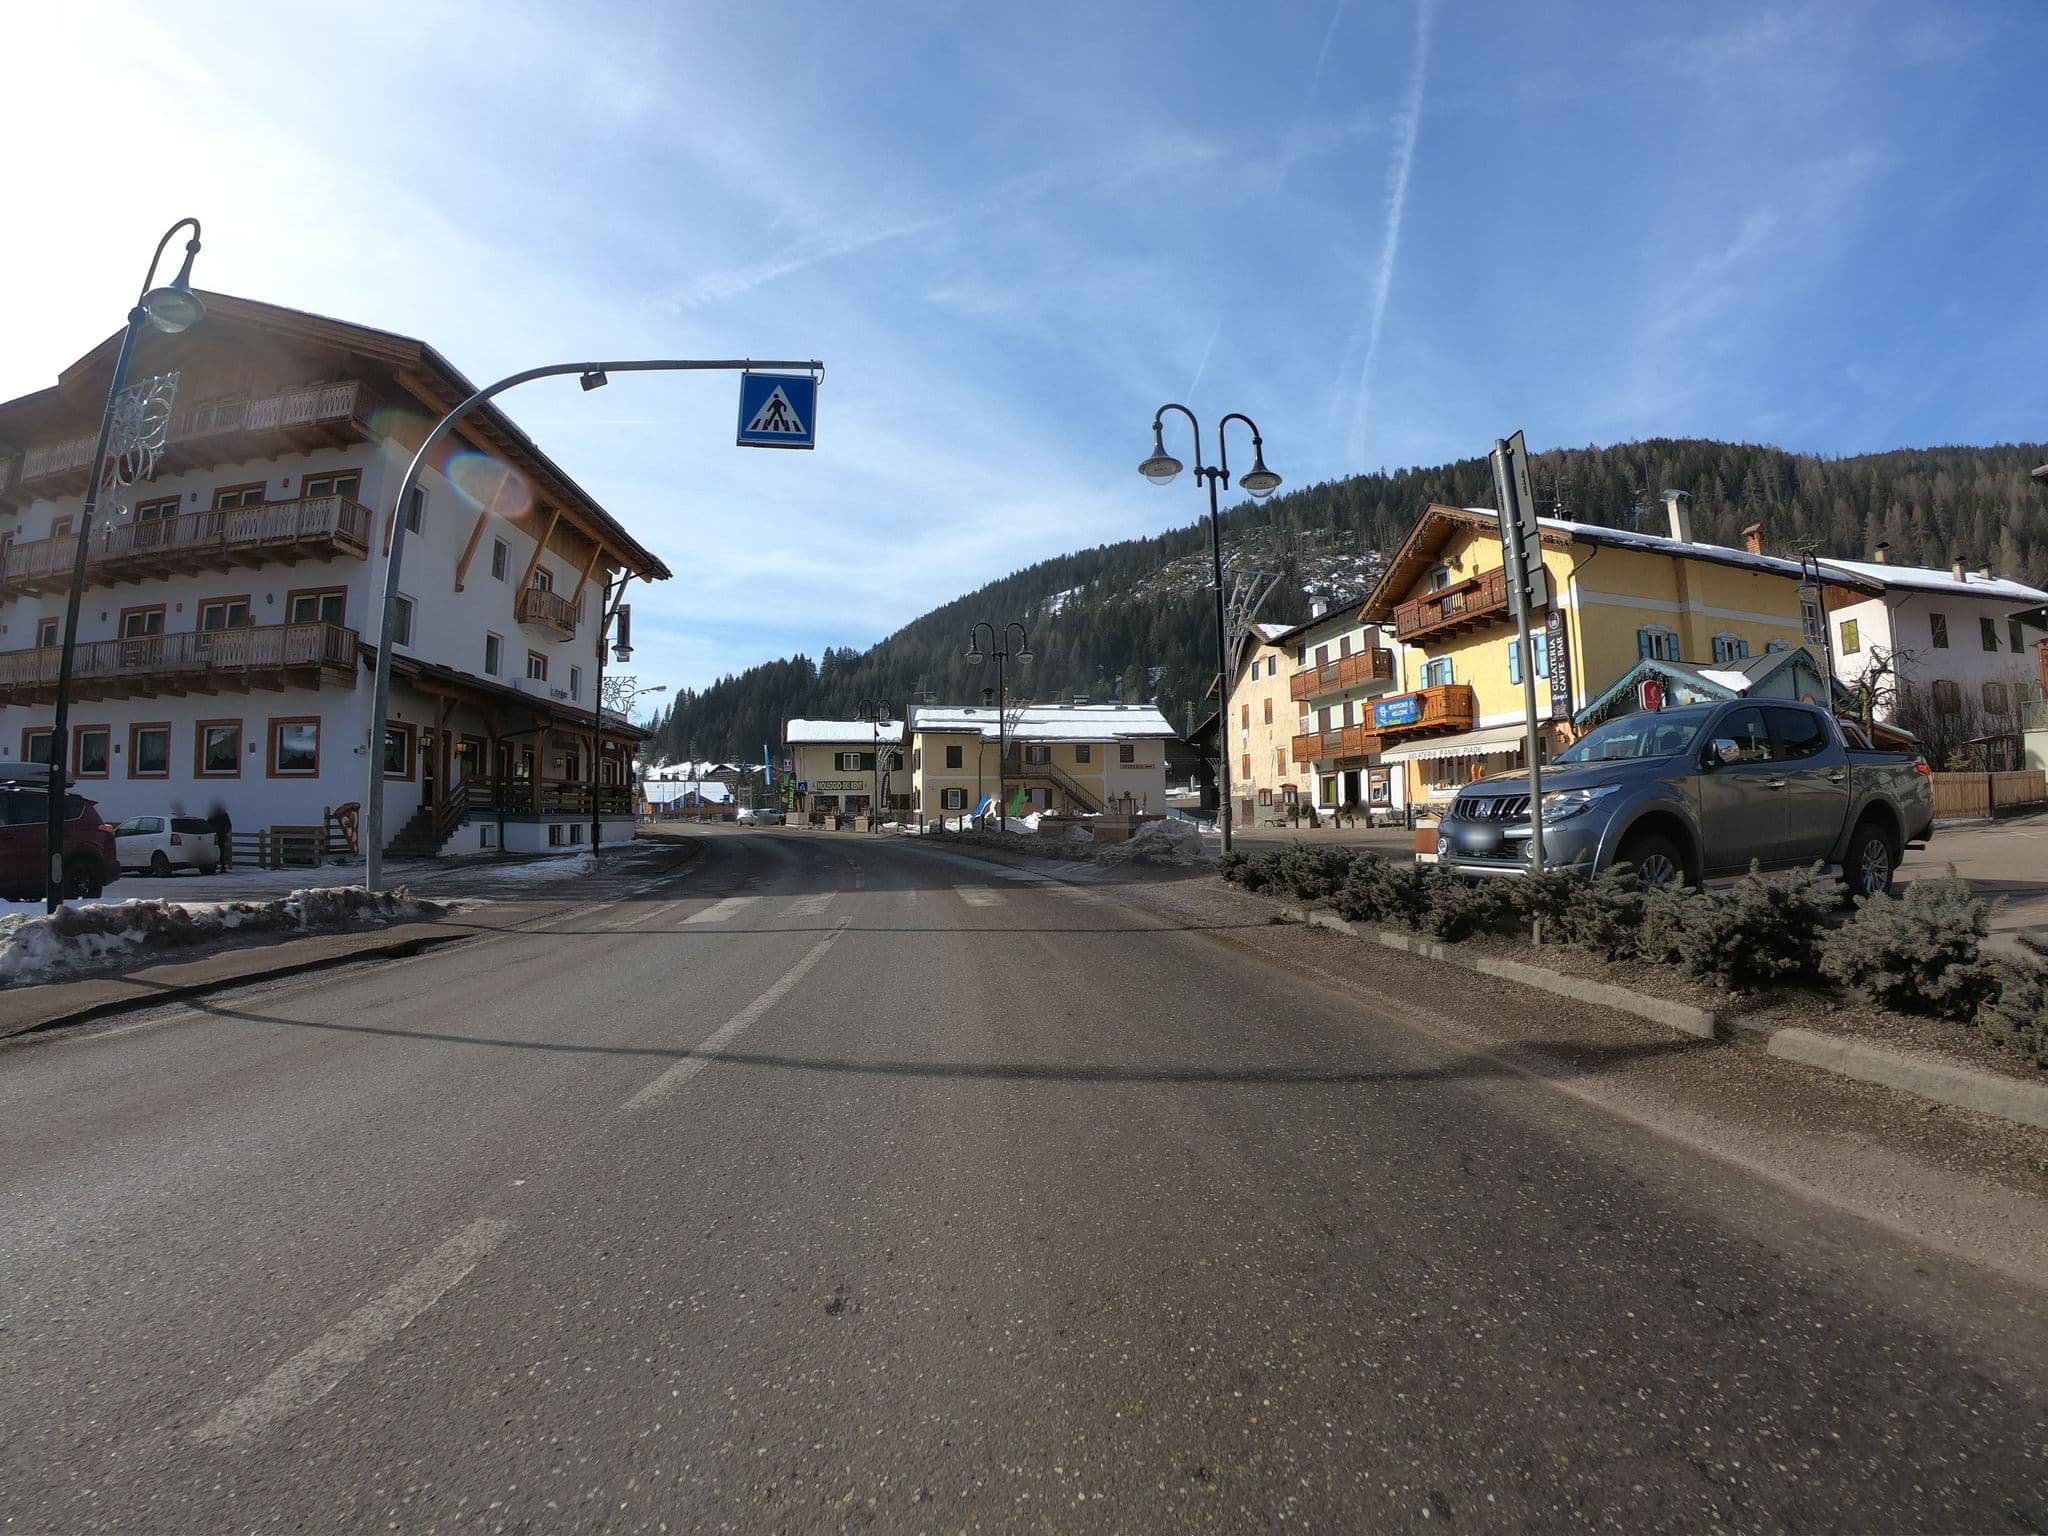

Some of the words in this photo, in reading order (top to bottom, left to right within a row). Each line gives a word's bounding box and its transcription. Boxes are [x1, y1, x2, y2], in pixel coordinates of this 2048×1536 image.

[1556, 636, 1564, 656] BAR
[1550, 638, 1559, 691] GELATERIA
[1408, 750, 1437, 760] GELATERIA
[1439, 748, 1460, 756] PANINI
